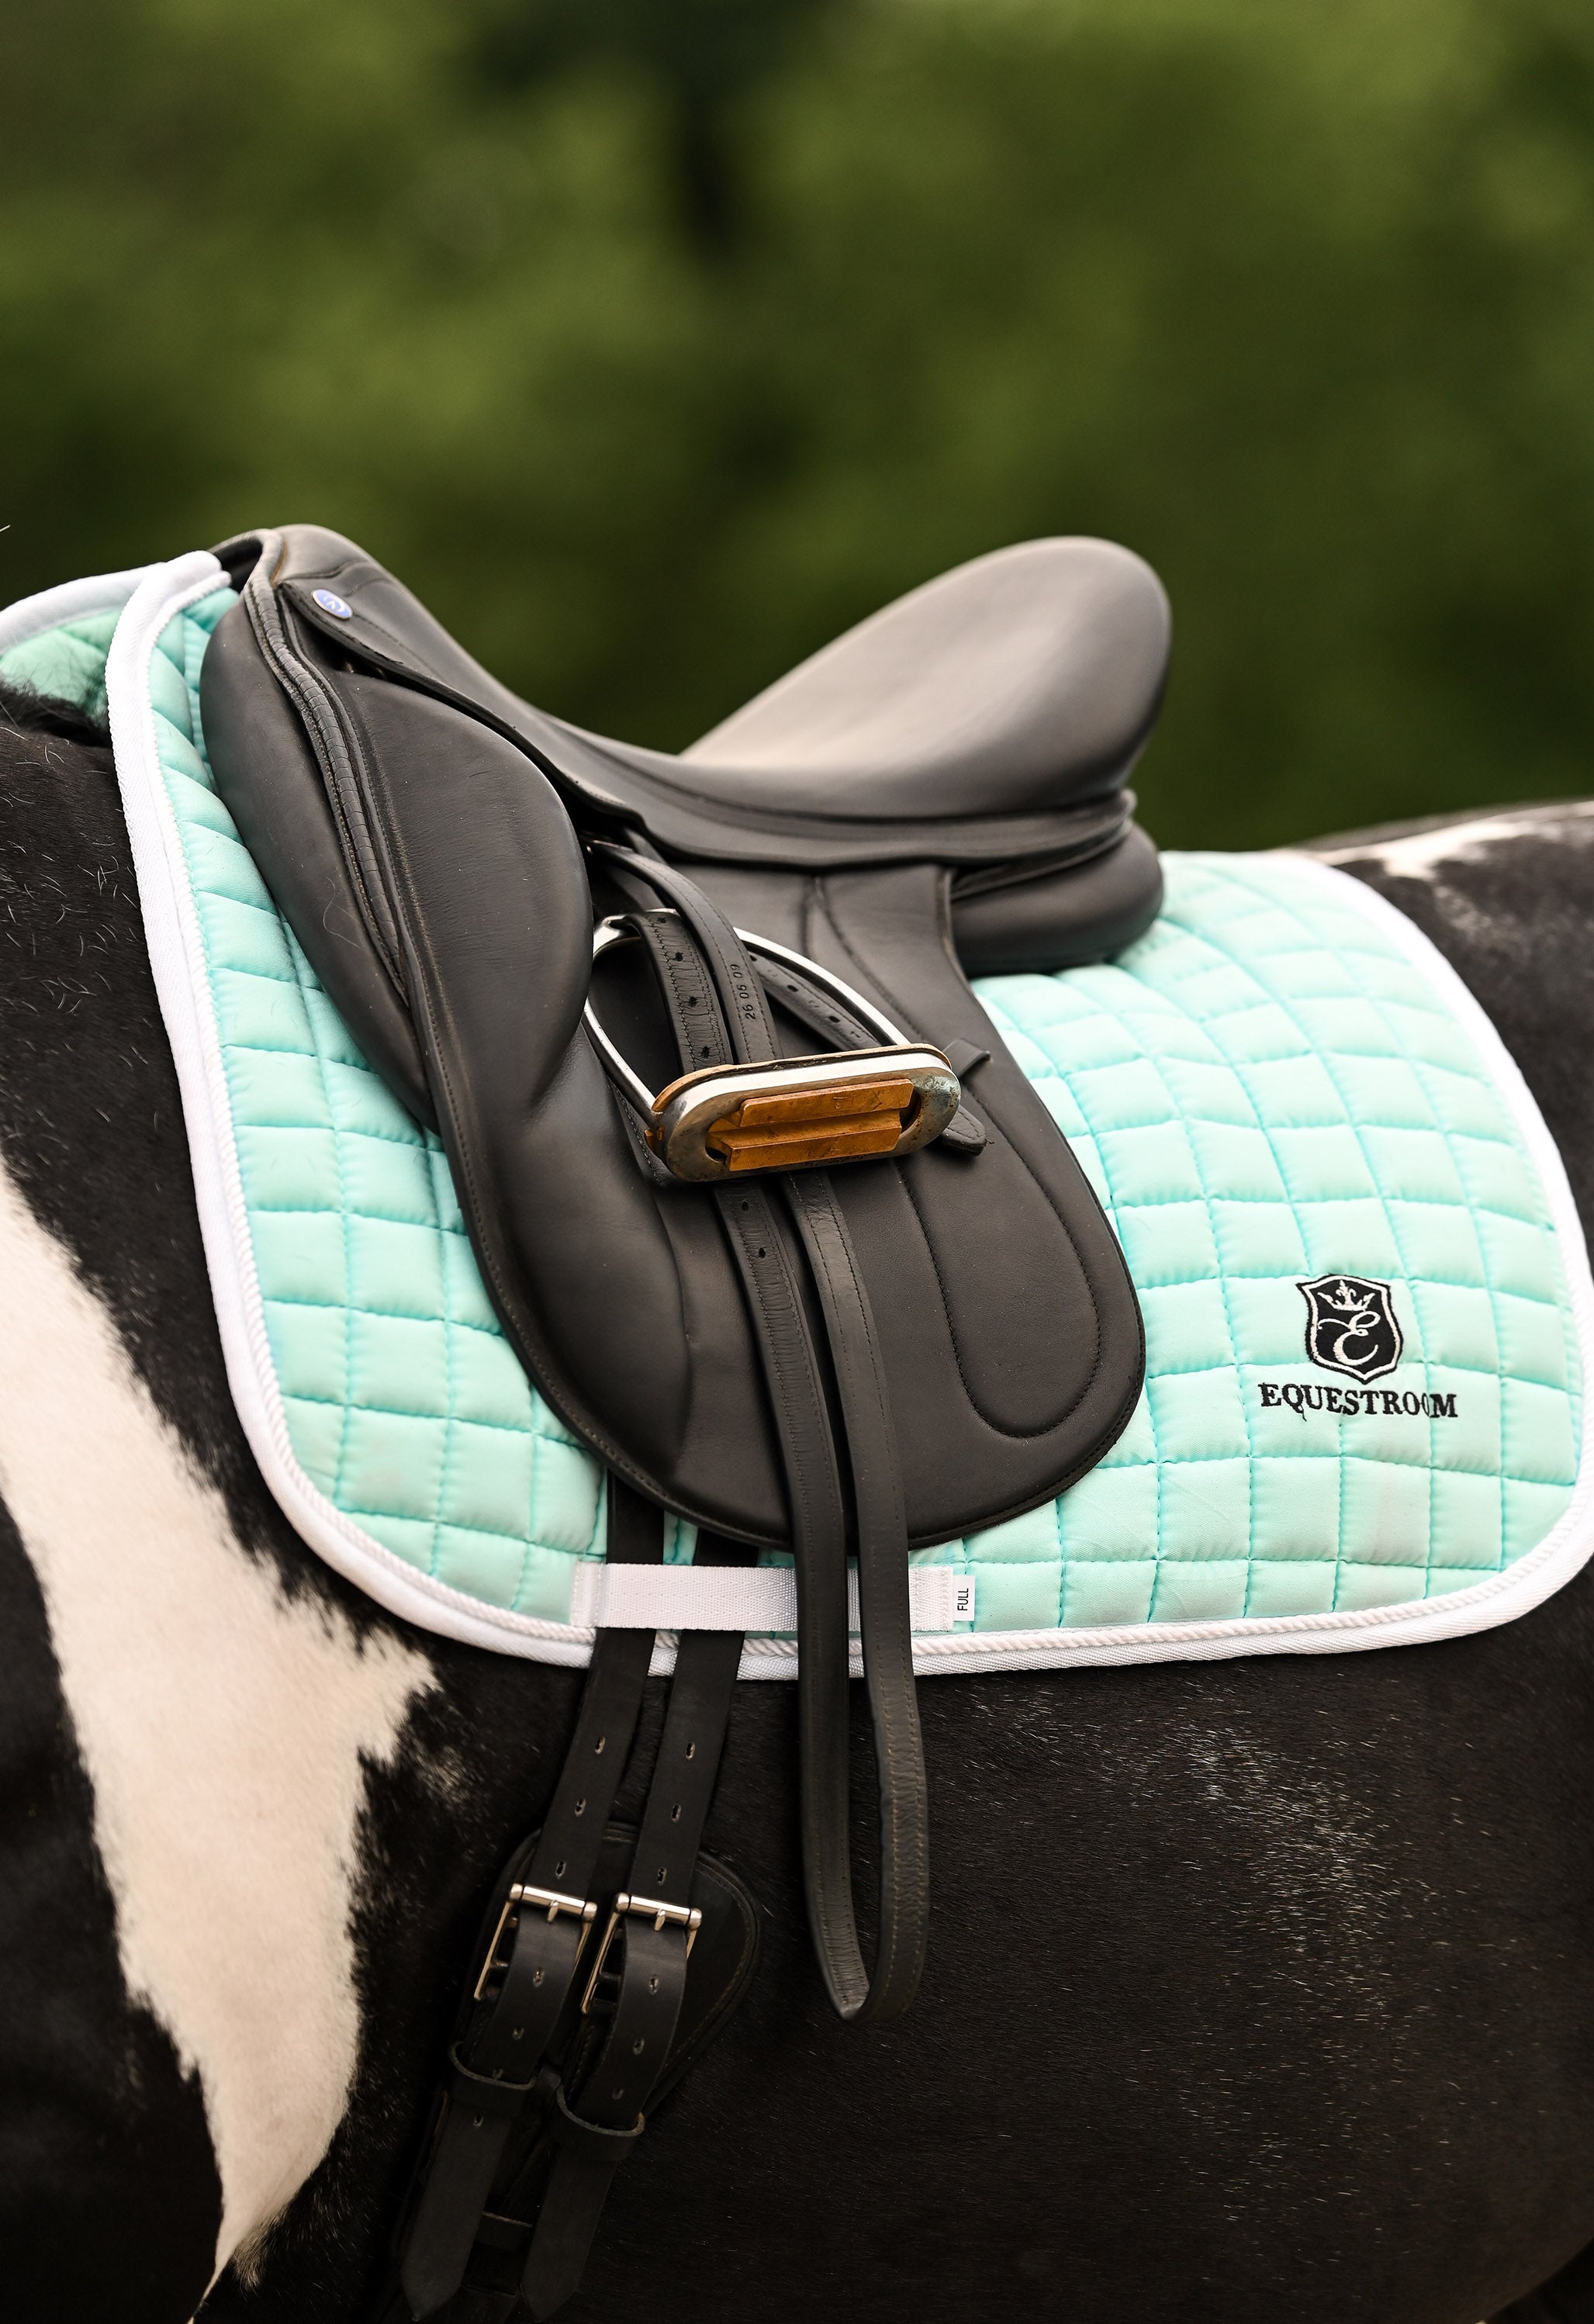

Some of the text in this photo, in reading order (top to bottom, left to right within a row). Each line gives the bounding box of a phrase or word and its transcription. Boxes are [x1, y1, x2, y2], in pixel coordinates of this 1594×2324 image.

[736, 984, 749, 999] 06
[742, 1004, 756, 1020] 26
[1317, 1310, 1381, 1366] E
[1257, 1382, 1459, 1419] EQUESTROOM
[956, 1587, 970, 1611] FULL
